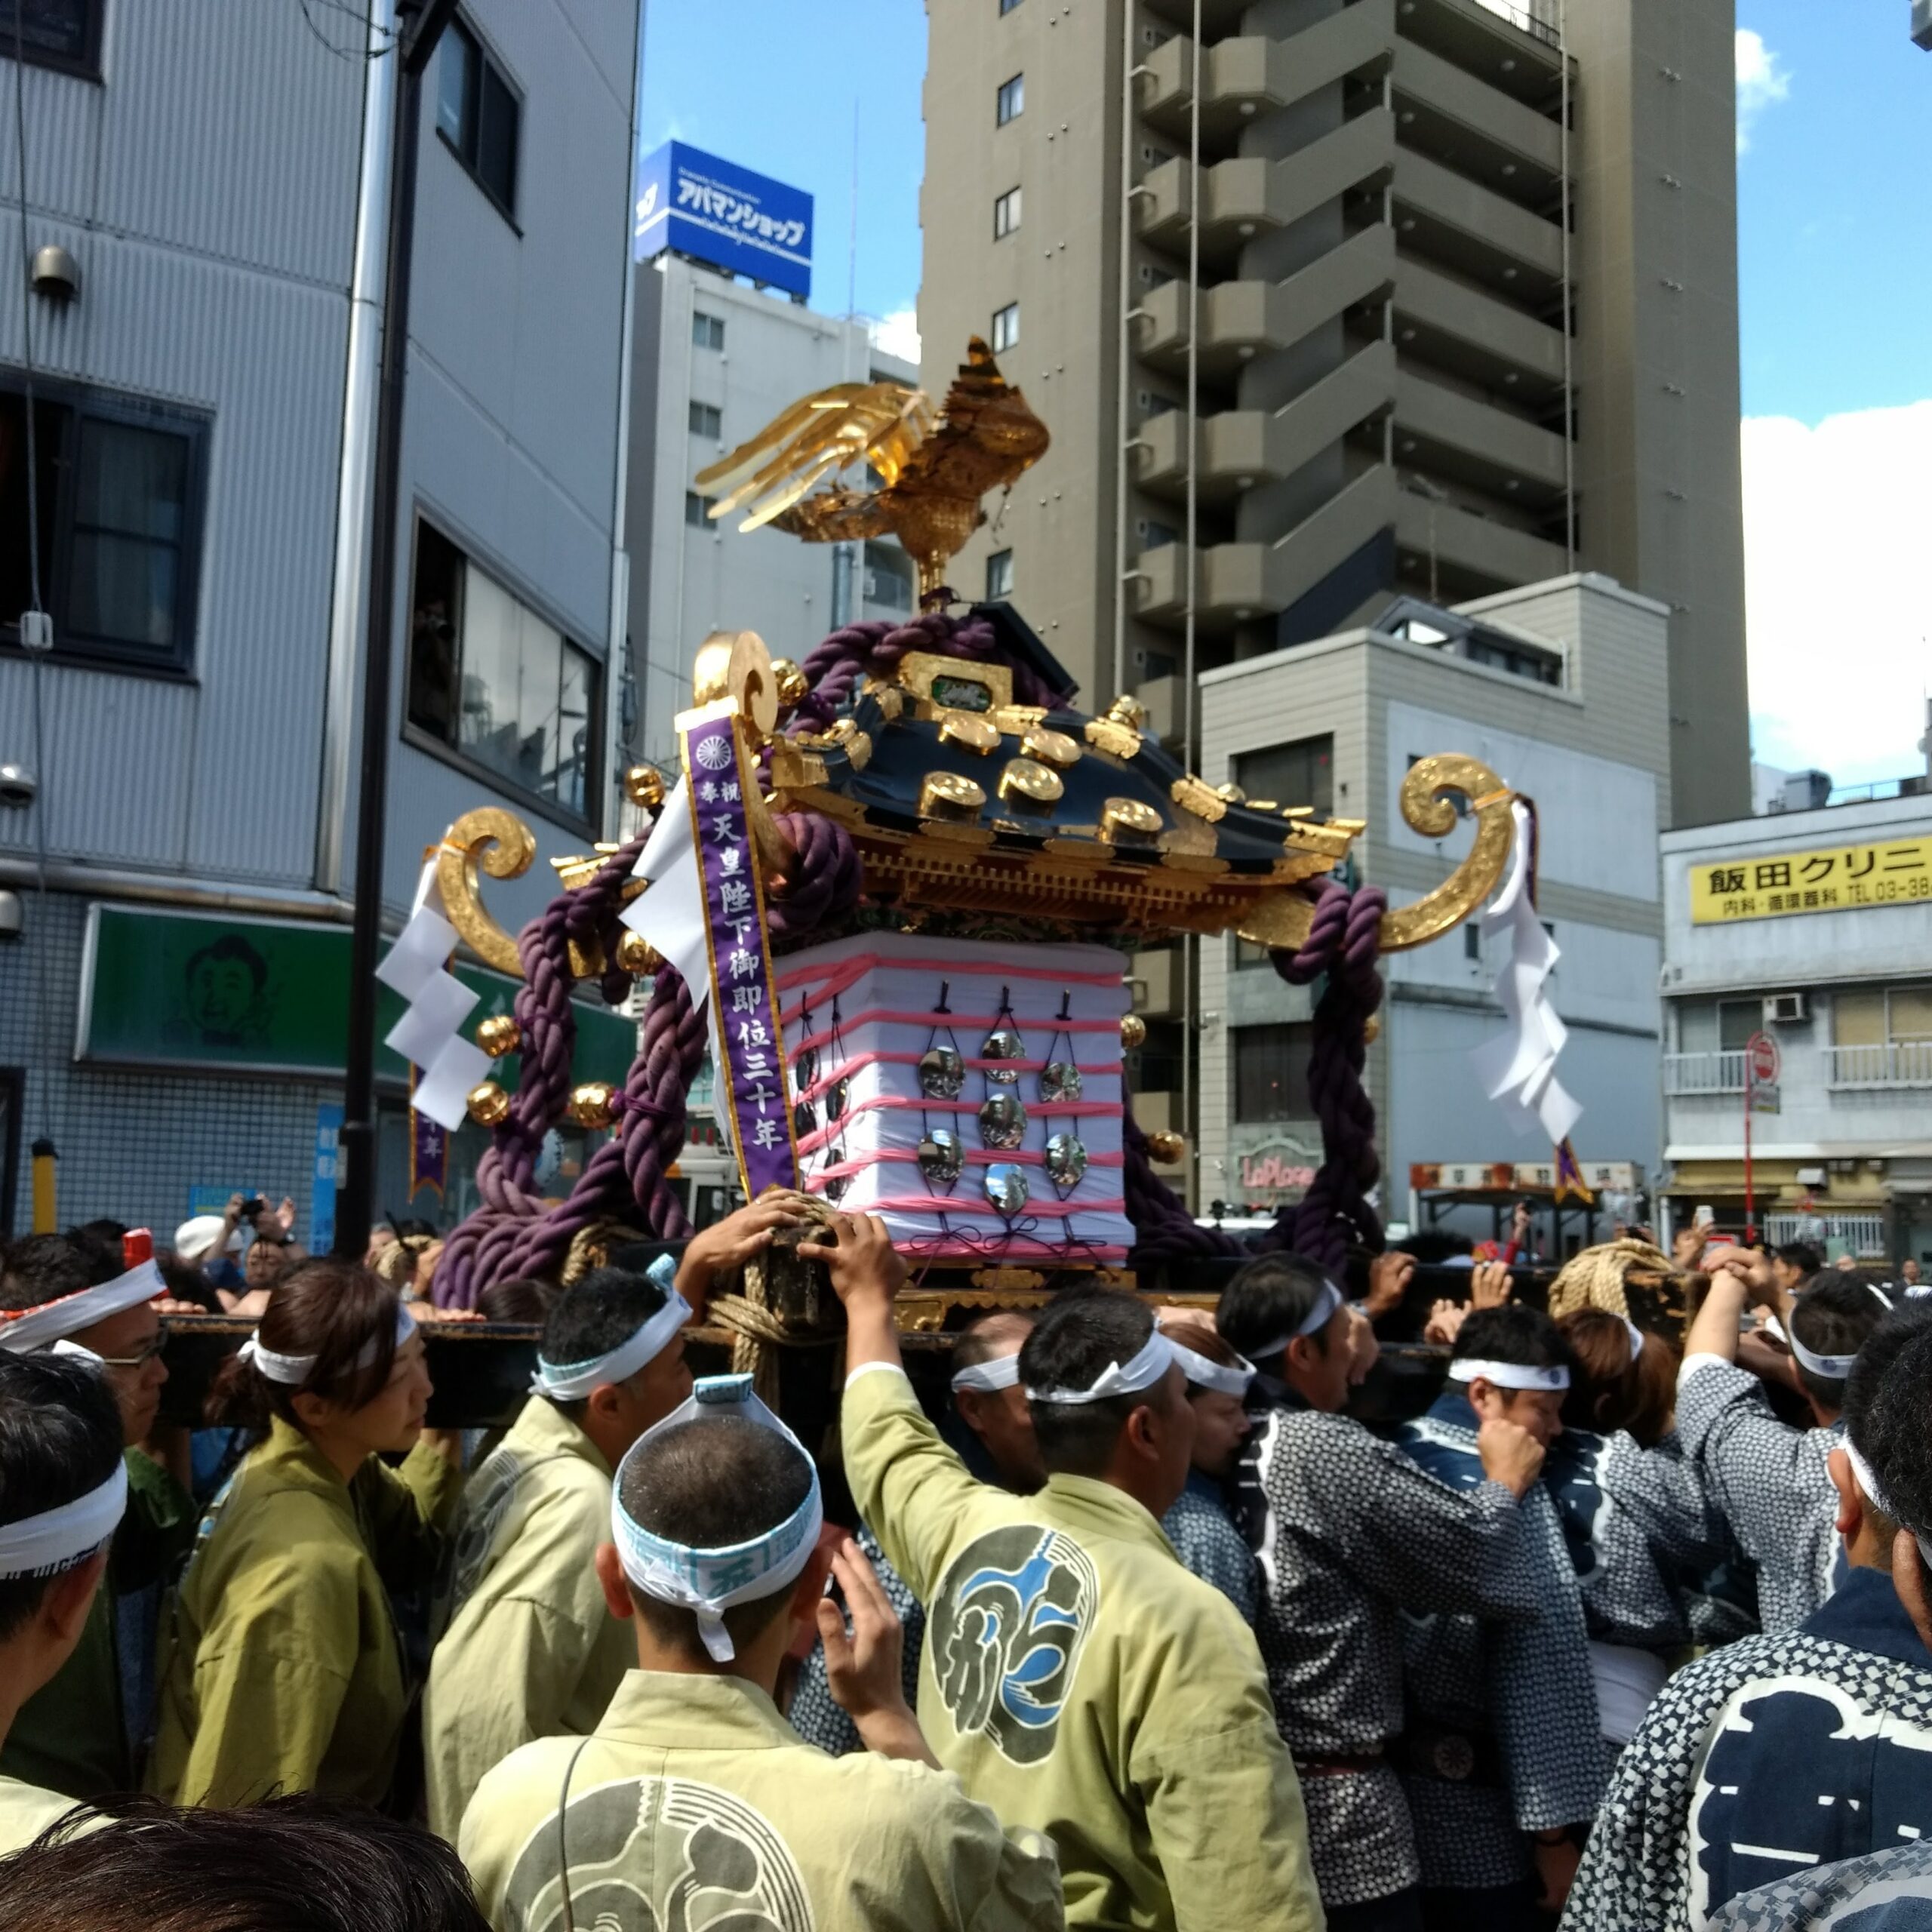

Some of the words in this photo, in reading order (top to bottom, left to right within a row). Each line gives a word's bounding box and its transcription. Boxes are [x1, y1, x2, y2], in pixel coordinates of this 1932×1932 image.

[1709, 848, 1925, 895] 飯田クリニ
[1847, 884, 1871, 903] TEL
[1875, 876, 1932, 900] 03-38
[712, 813, 783, 1151] 天皇陛下御即位三十年
